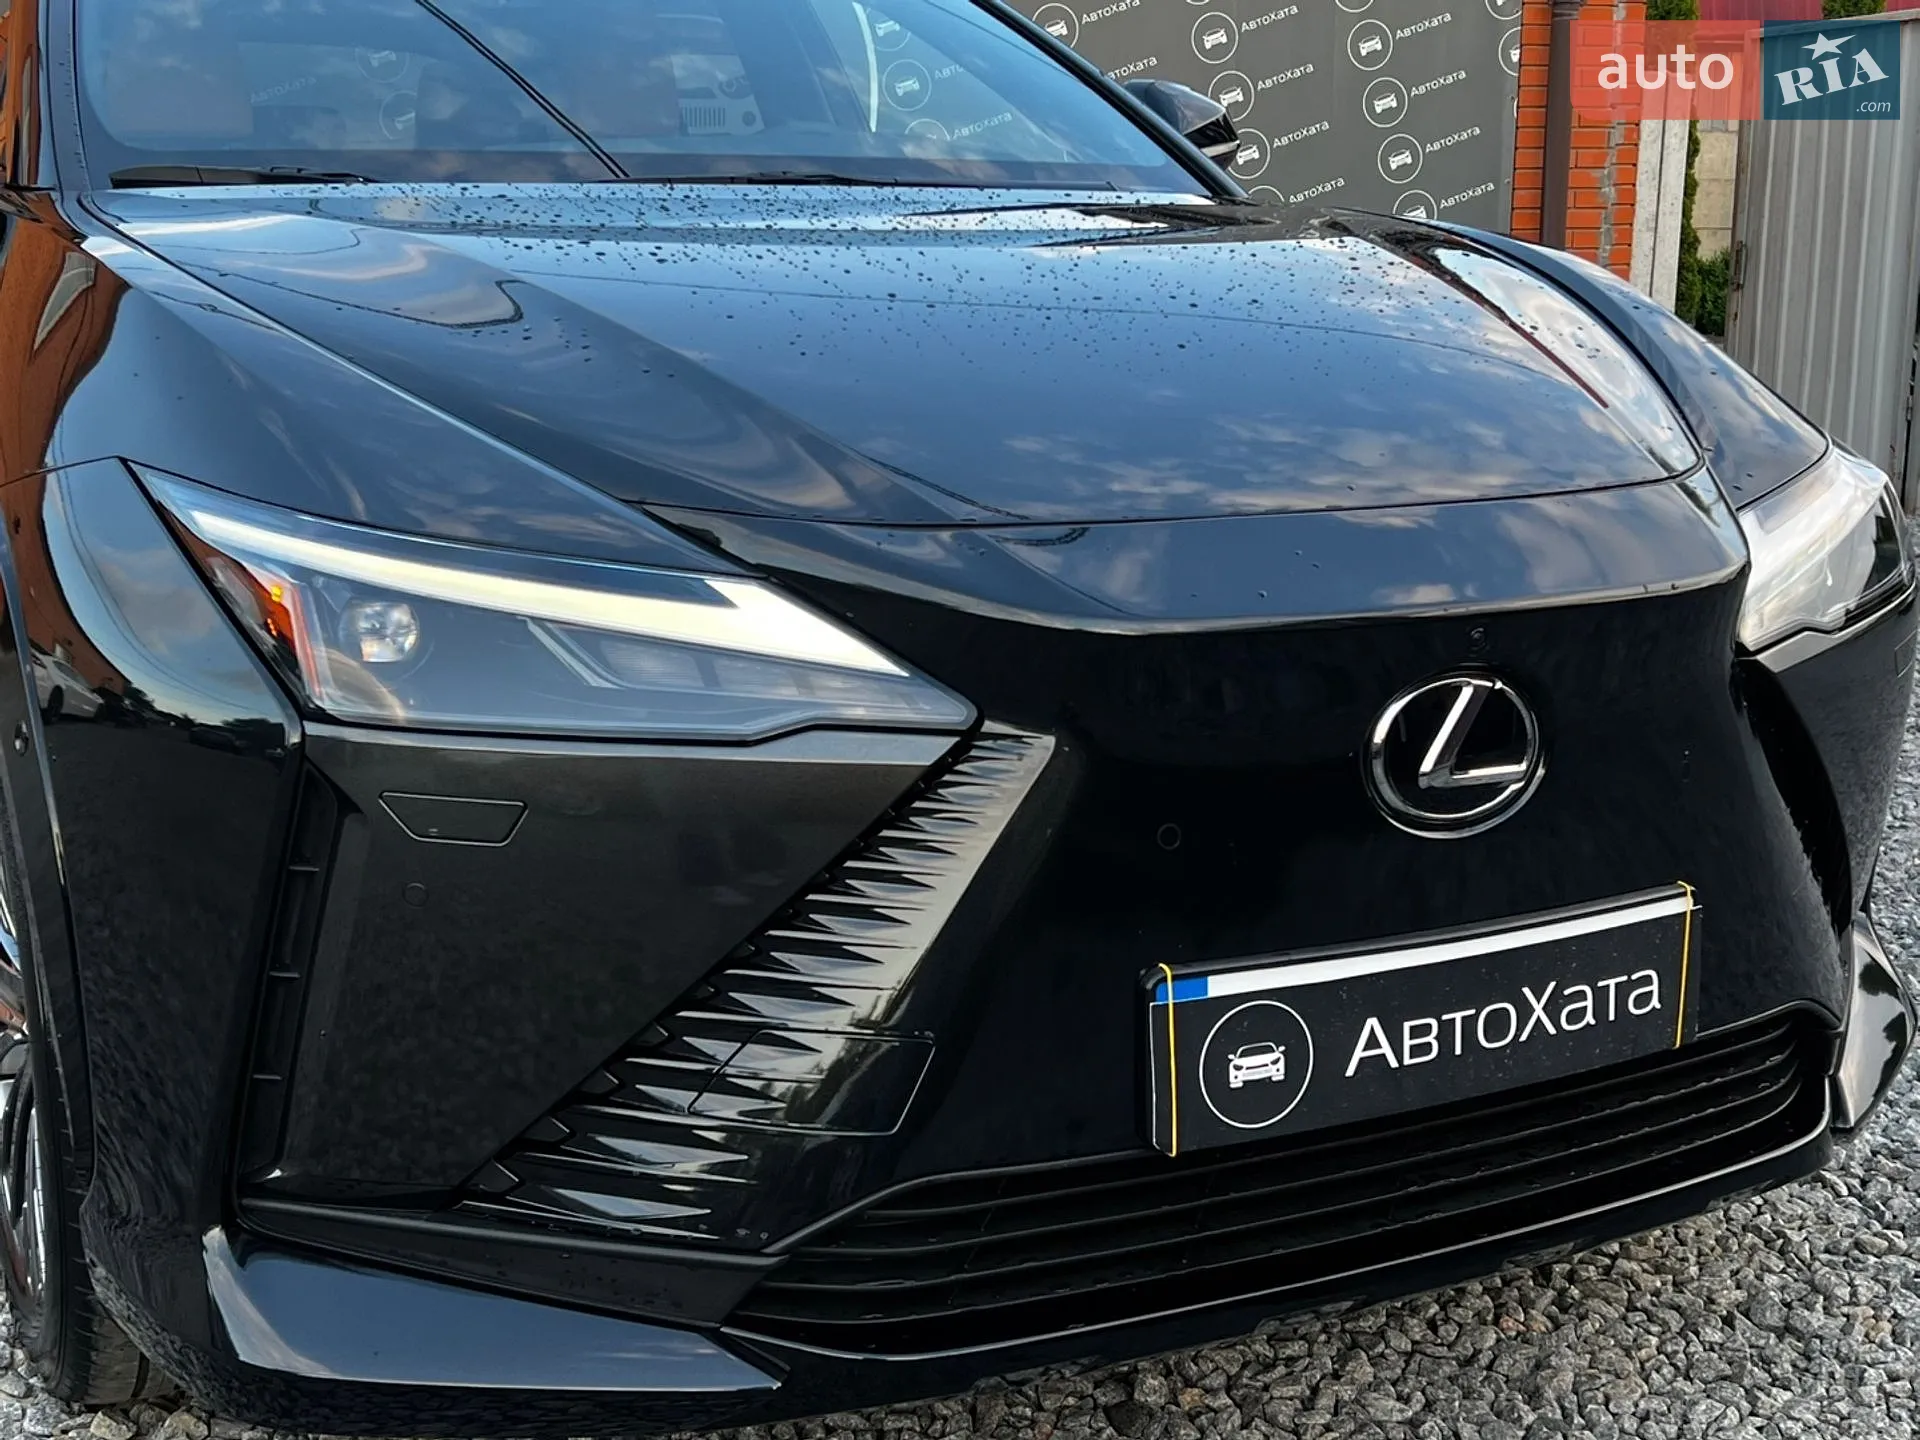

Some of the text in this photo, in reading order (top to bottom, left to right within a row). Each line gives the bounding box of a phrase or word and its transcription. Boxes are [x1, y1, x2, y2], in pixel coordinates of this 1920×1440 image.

[1081, 0, 1141, 25] АвтоХата
[1241, 4, 1299, 33] АвтоХата
[1395, 11, 1453, 40] АвтоХата
[1257, 62, 1315, 91] АвтоХата
[1410, 69, 1467, 97] АвтоХата
[953, 111, 1013, 140] АвтоХата
[1272, 120, 1330, 149] АвтоХата
[1425, 125, 1482, 153] АвтоХата
[1288, 176, 1346, 205] АвтоХата
[1439, 181, 1496, 210] АвтоХата
[1344, 968, 1662, 1078] АвтоХата
